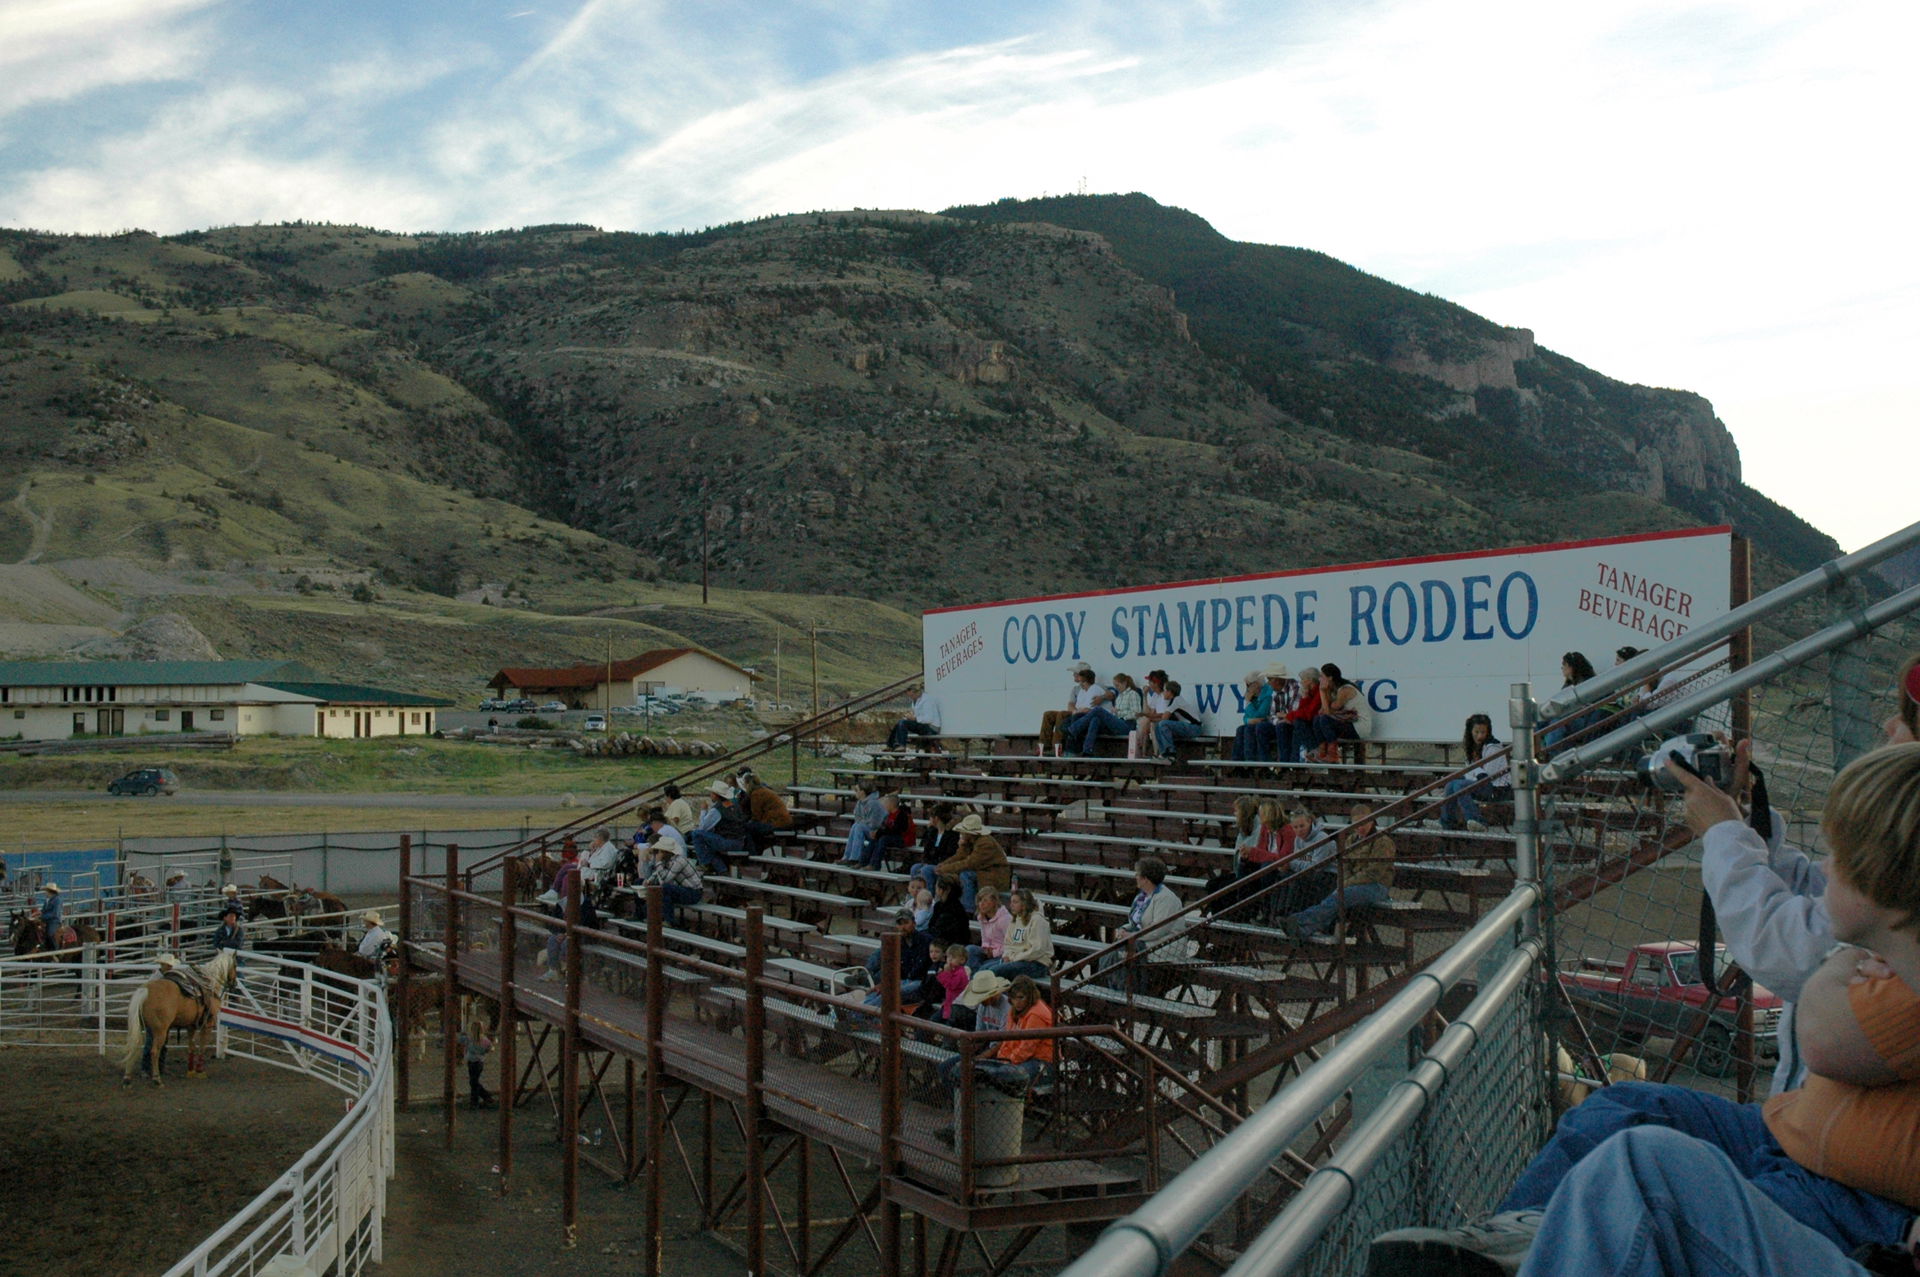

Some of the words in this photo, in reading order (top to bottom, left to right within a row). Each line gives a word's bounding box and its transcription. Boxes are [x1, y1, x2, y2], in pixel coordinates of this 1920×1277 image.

[1578, 588, 1689, 642] BEVERAGE
[1596, 562, 1693, 618] TANAGER
[939, 620, 978, 659] TANAGER
[1002, 610, 1087, 665] CODY
[1110, 590, 1320, 660] STAMPEDE
[1348, 570, 1539, 646] RODEO
[935, 635, 984, 682] BEVERAGES
